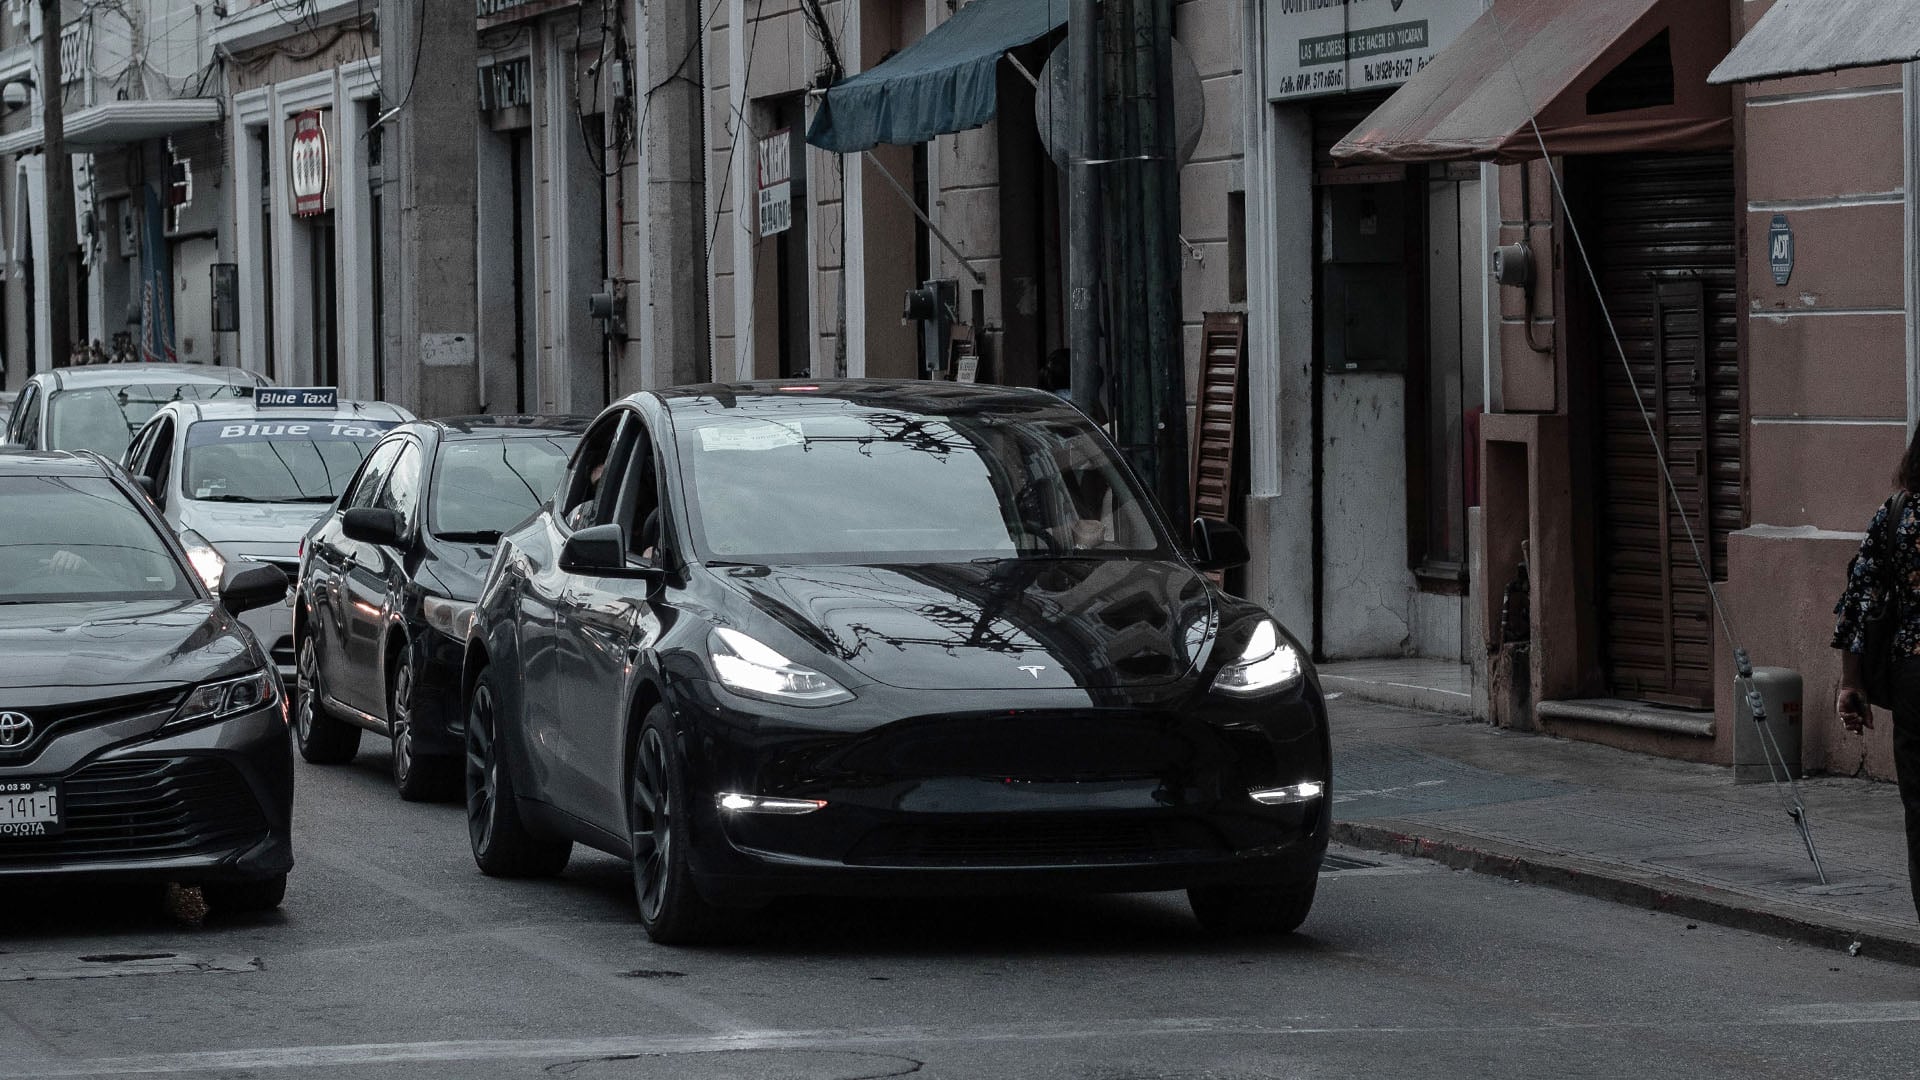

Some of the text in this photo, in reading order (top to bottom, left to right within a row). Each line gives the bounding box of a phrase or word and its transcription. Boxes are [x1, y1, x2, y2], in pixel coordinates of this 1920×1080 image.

[1301, 44, 1312, 60] LAS
[1315, 39, 1342, 58] MEJORES
[1358, 35, 1365, 51] SE
[1366, 32, 1386, 50] HACEN
[1387, 31, 1395, 47] EN
[1397, 26, 1423, 45] YUCATAN
[1296, 74, 1304, 92] 60
[1772, 234, 1789, 259] ADT
[260, 392, 334, 404] Blue Taxi
[220, 423, 390, 438] Blue Tax
[7, 783, 18, 791] 03
[20, 783, 31, 791] 30
